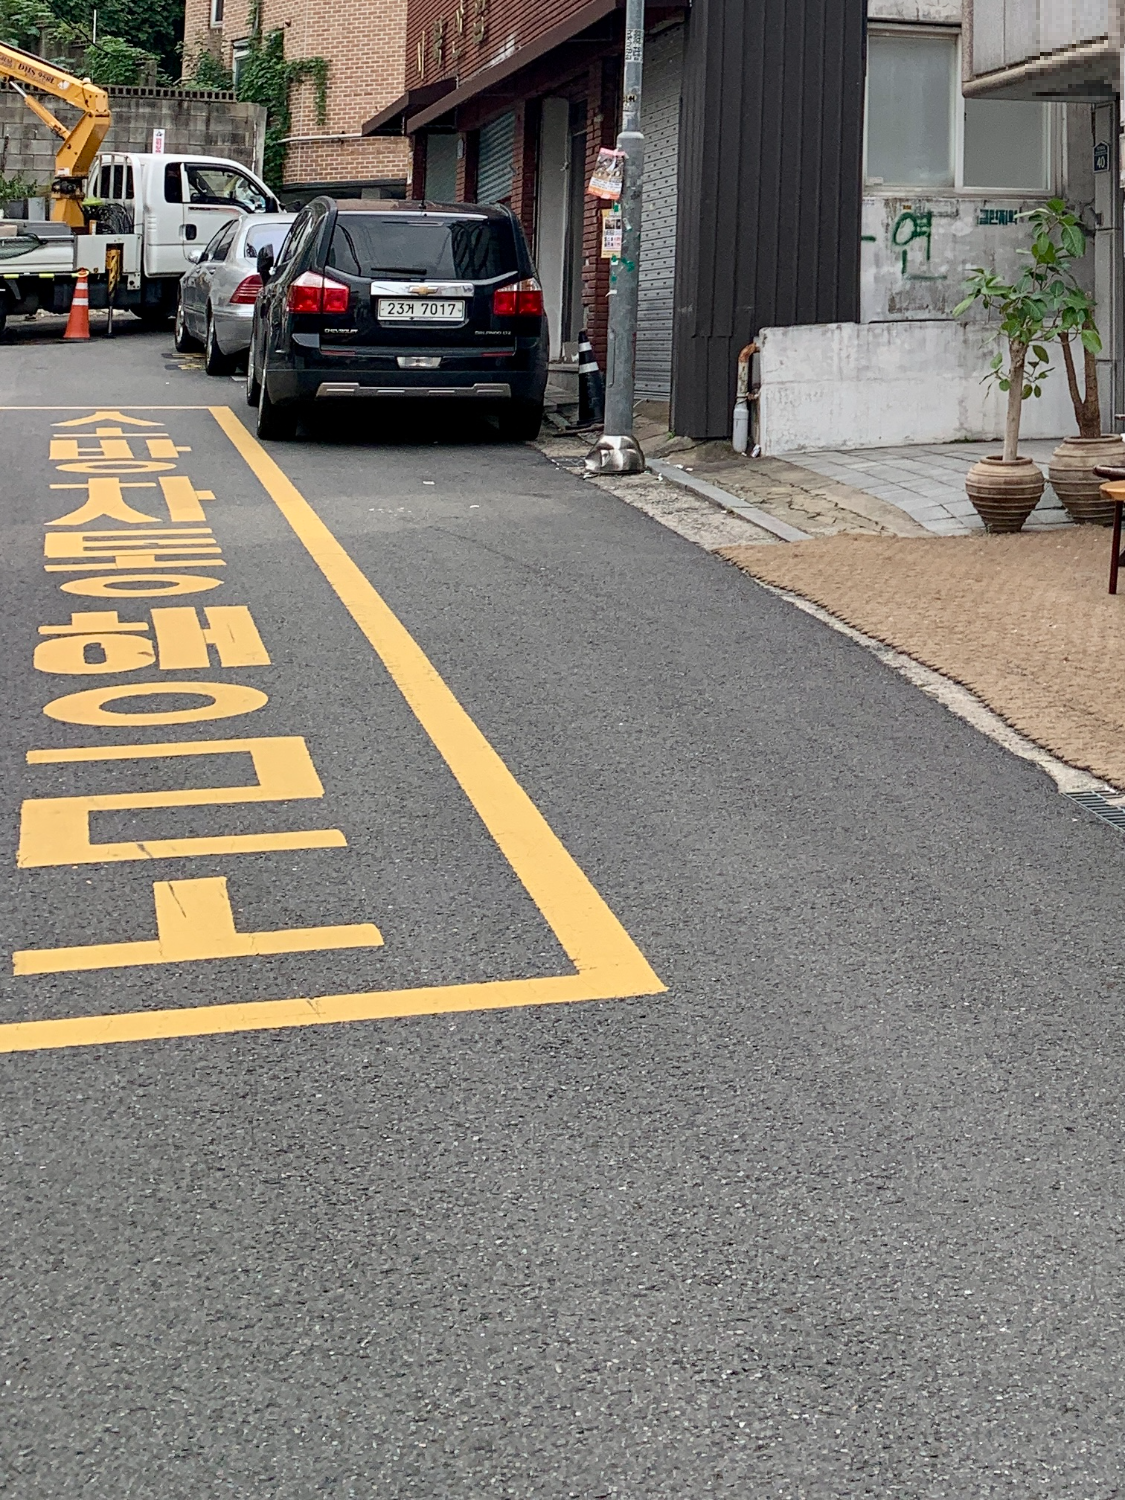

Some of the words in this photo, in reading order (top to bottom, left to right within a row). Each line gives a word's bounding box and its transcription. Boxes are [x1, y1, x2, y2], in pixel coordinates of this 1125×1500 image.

[1096, 156, 1106, 169] 40
[861, 211, 948, 280] 연
[387, 302, 415, 315] 23거
[421, 303, 456, 316] 7017
[13, 411, 385, 976] 소방차통행로
